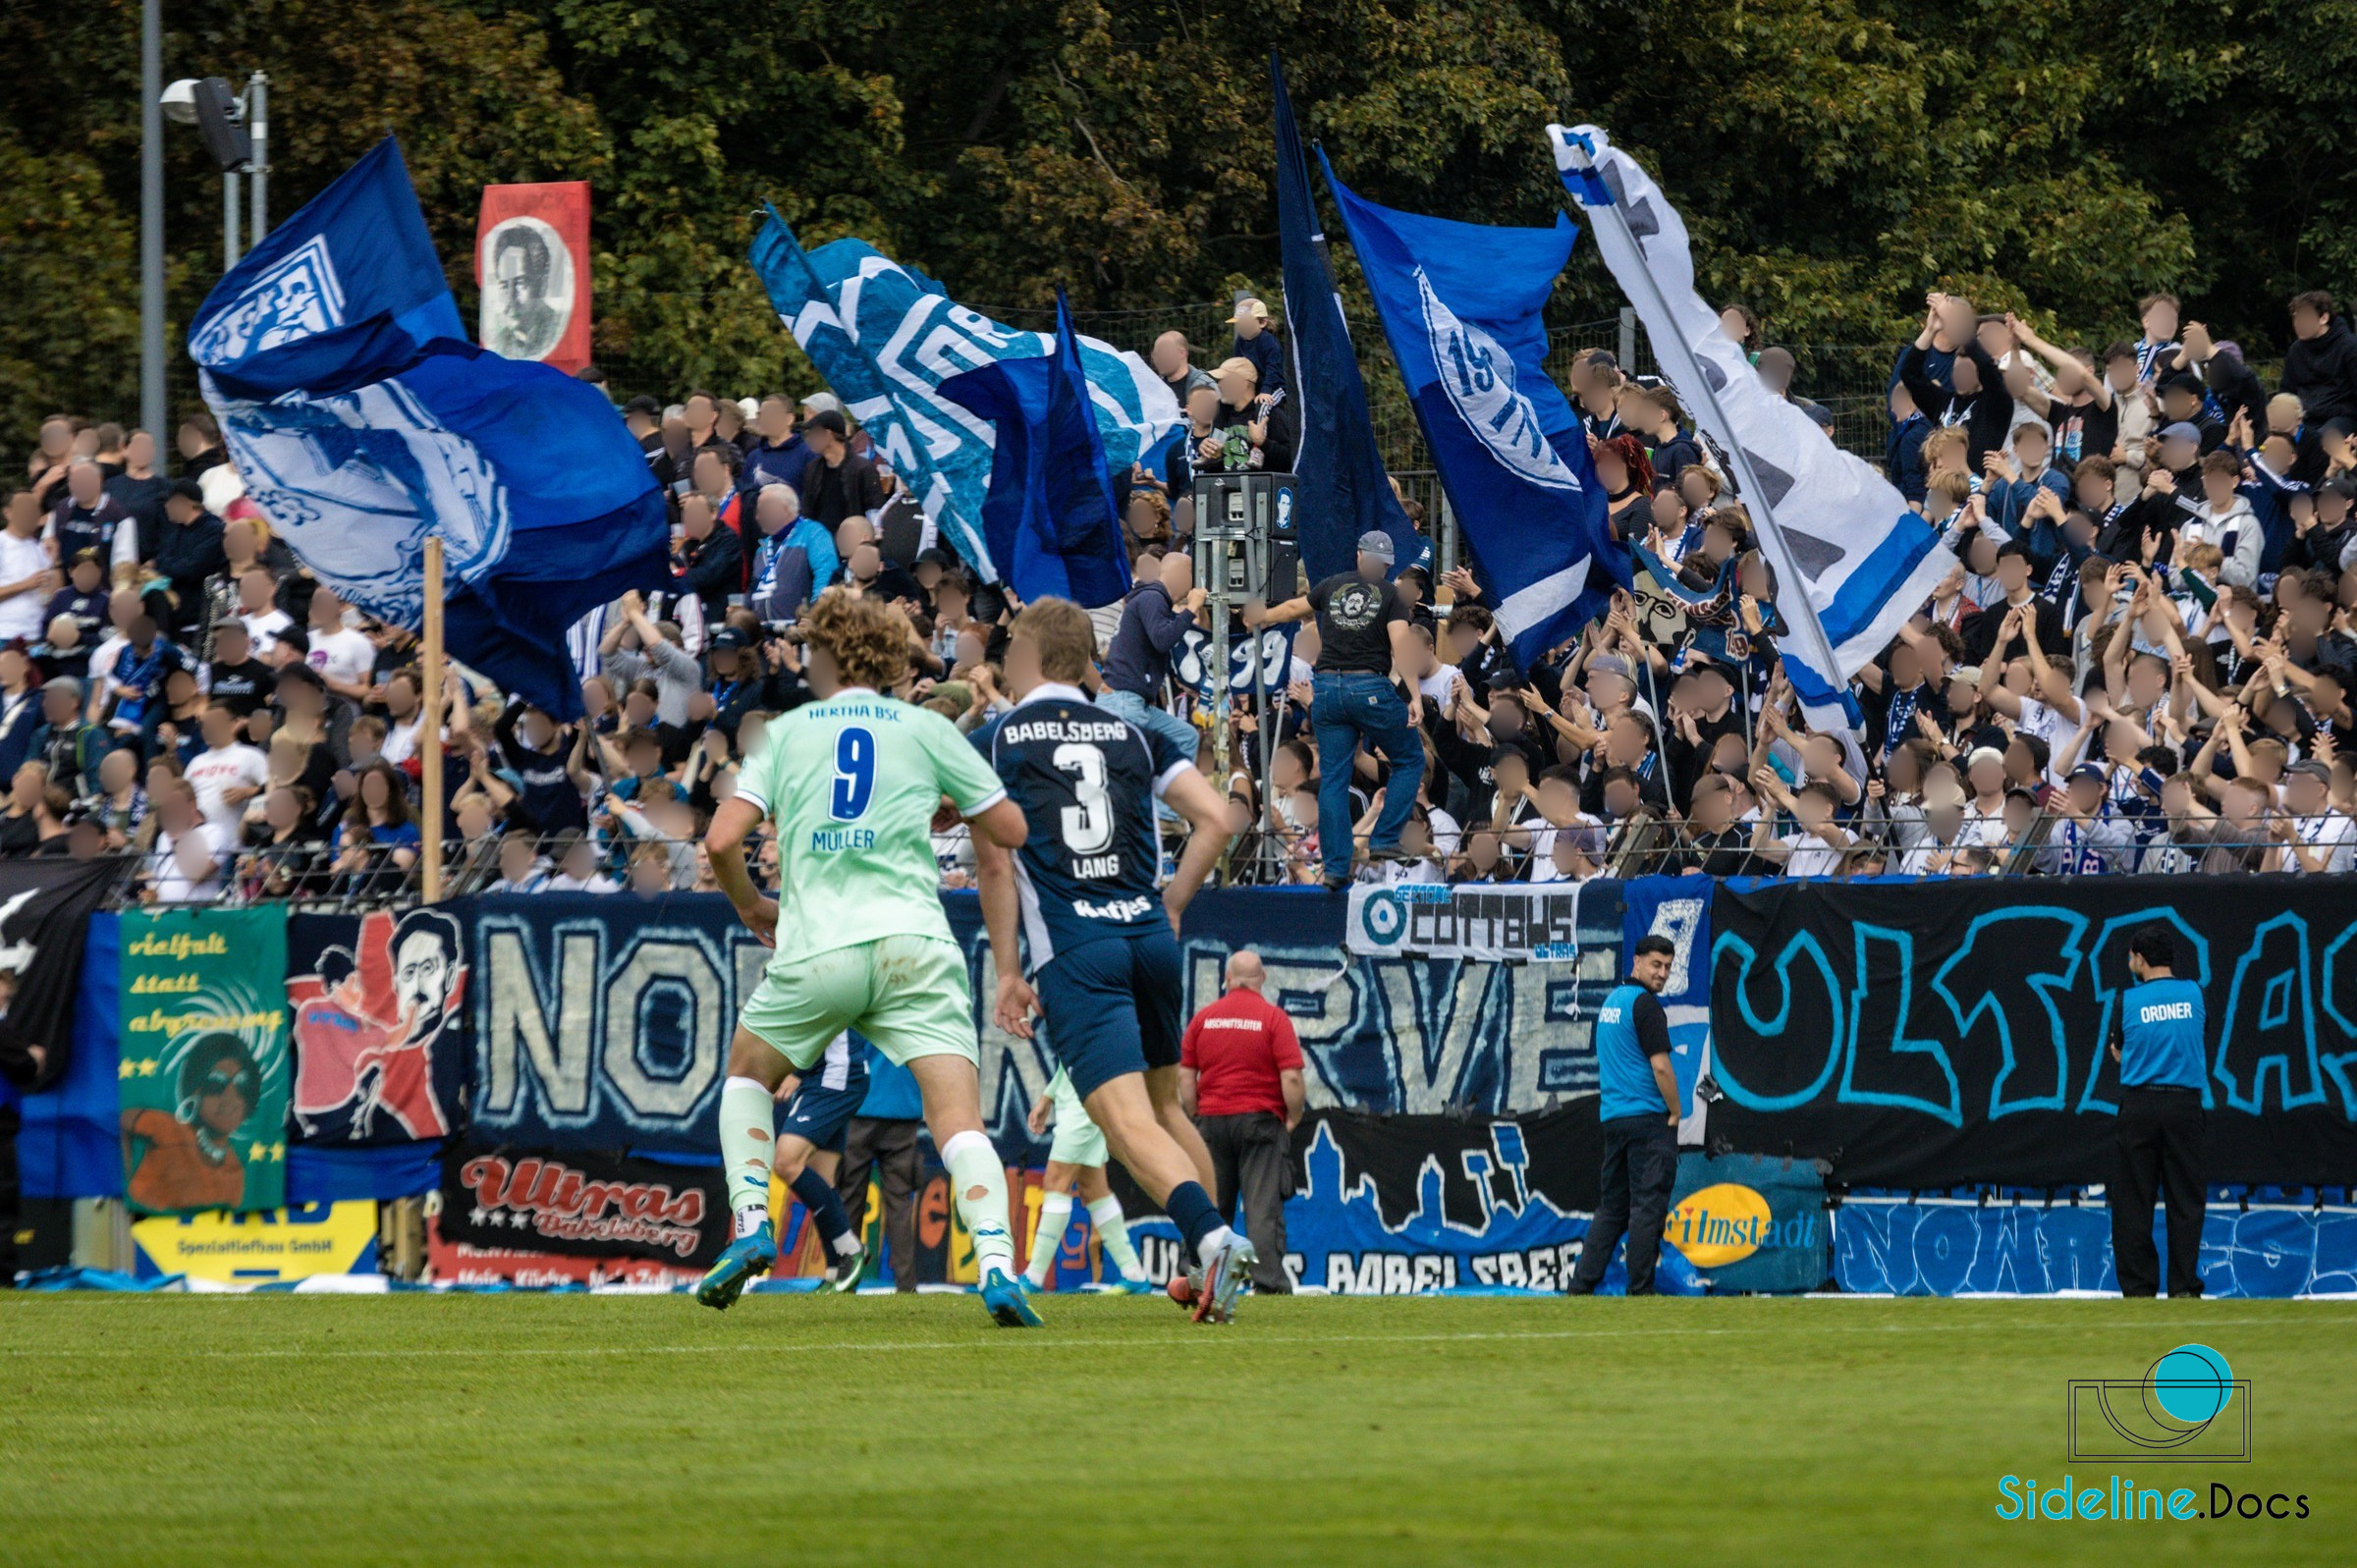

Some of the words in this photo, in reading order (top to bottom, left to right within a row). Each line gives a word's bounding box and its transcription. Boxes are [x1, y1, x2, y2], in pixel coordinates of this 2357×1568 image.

[809, 705, 870, 720] HERTHA
[875, 705, 902, 722] BSC
[1004, 721, 1127, 744] BABELSBERG
[829, 724, 877, 823] 9
[1053, 743, 1115, 854] 3
[812, 829, 874, 851] MÜLLER
[1072, 854, 1120, 879] LANG
[1410, 892, 1572, 948] COTTBUS
[129, 931, 229, 960] vielfalt
[129, 973, 199, 994] statt
[2140, 1001, 2193, 1024] ORDNER
[461, 1154, 706, 1226] Ultras
[289, 1239, 333, 1252] GmbH
